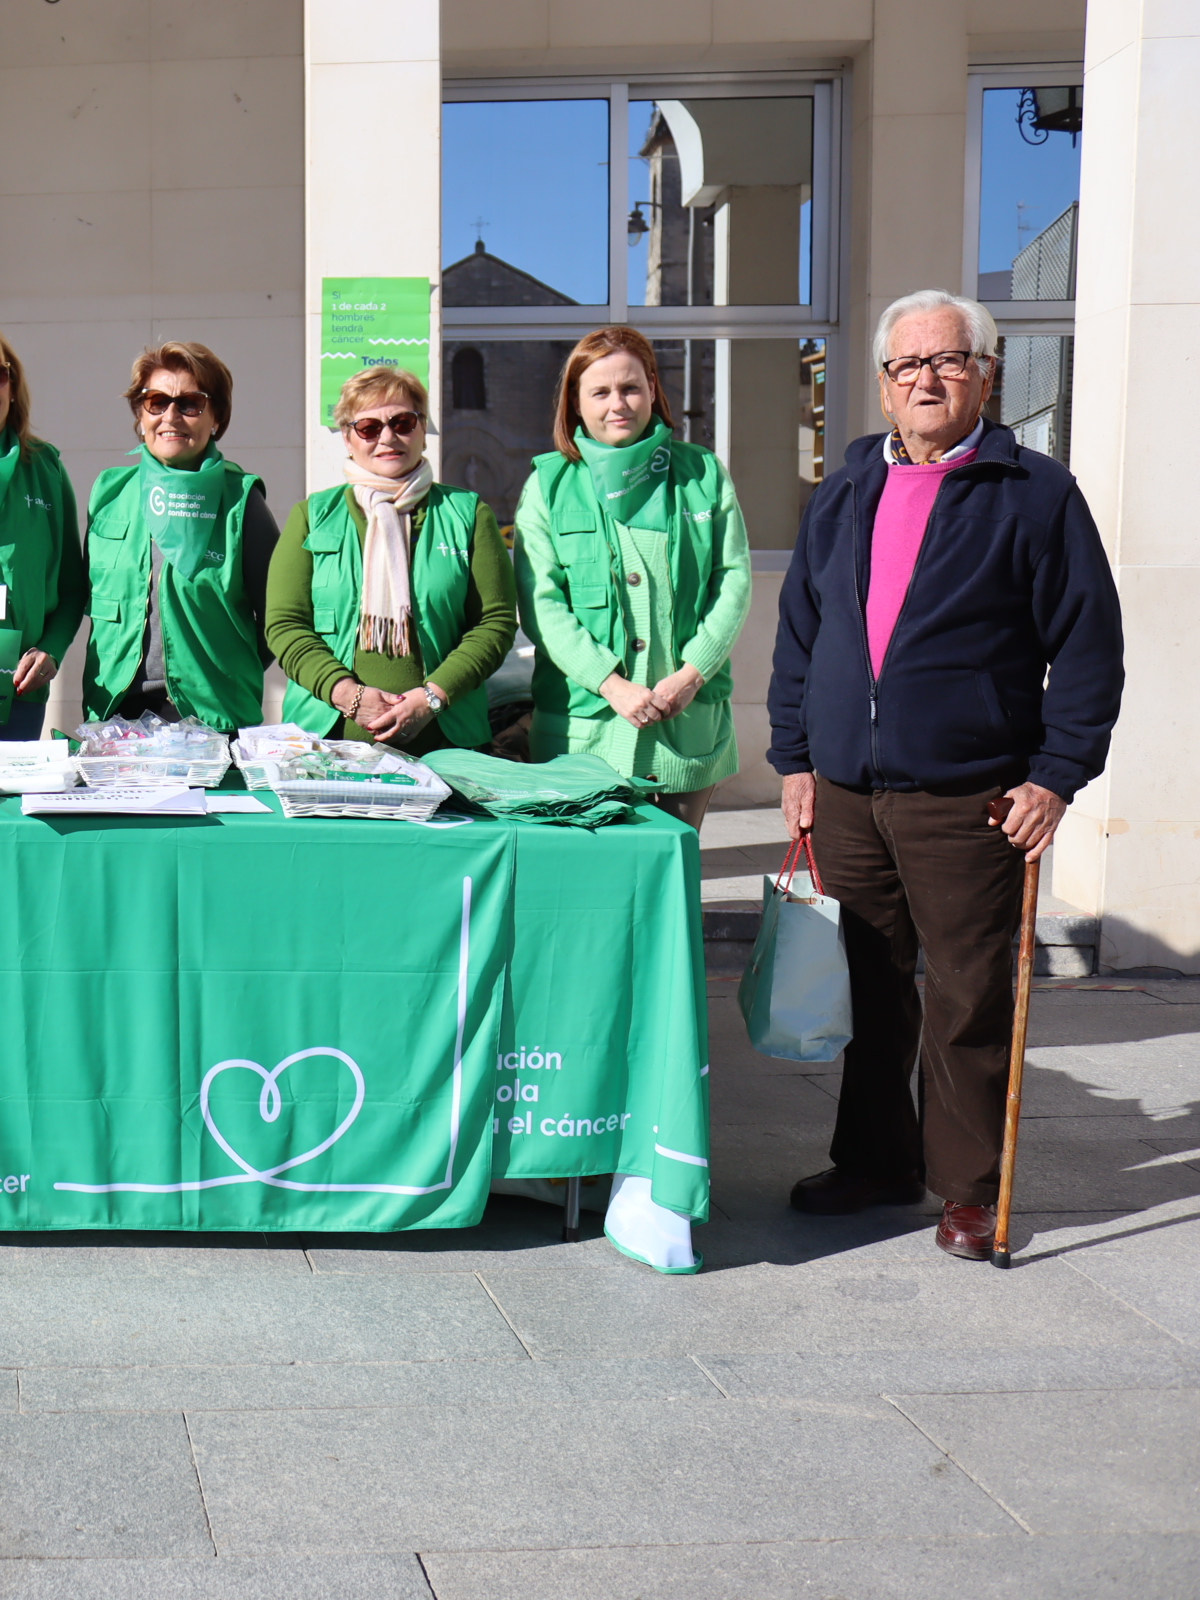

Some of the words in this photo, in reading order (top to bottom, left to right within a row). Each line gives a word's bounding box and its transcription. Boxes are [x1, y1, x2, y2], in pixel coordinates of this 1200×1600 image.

[332, 291, 341, 299] Si
[339, 302, 352, 310] de
[354, 302, 378, 310] cada
[332, 313, 375, 321] hombres
[332, 324, 363, 332] tendrá
[332, 335, 364, 343] cáncer
[361, 356, 398, 366] Todos
[169, 493, 205, 501] asociación
[168, 501, 200, 509] española
[168, 510, 190, 518] contra
[508, 1111, 532, 1135] el
[540, 1113, 632, 1136] cáncer
